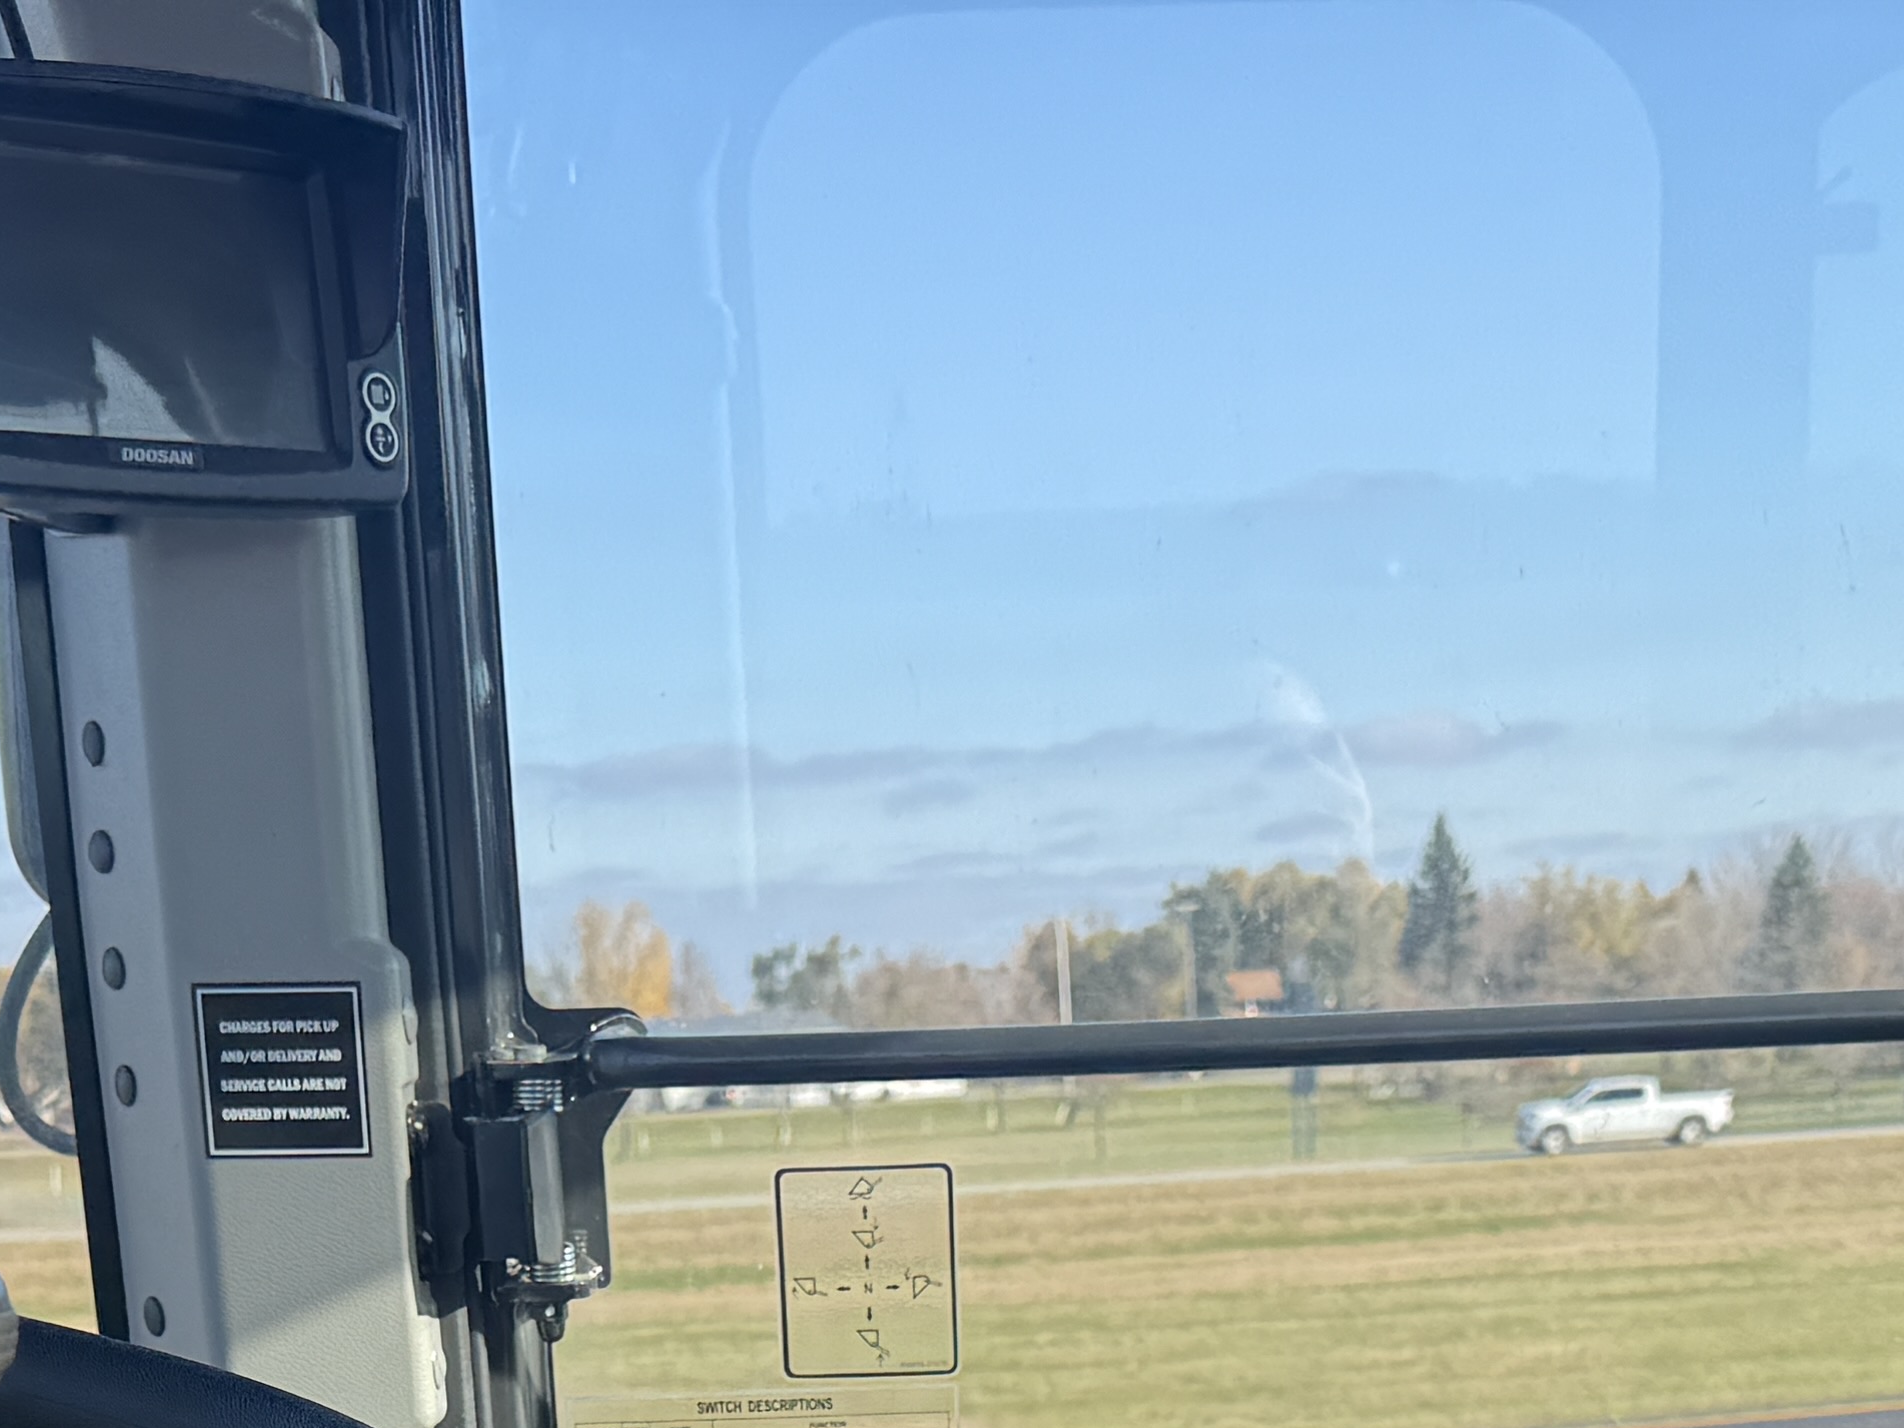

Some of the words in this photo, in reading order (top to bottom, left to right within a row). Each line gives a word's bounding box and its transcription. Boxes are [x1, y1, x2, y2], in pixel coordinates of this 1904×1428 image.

[121, 447, 194, 465] DOOSAN
[219, 1020, 271, 1033] CHARGES
[272, 1020, 294, 1033] FOR
[296, 1020, 322, 1033] PICK
[323, 1020, 339, 1032] UP
[220, 1050, 266, 1065] AND/OR
[268, 1049, 318, 1062] DELIVERY
[318, 1048, 342, 1062] AND
[221, 1079, 266, 1092] SERVICE
[267, 1078, 301, 1091] CALLS
[302, 1078, 324, 1091] ARE
[325, 1077, 347, 1091] NOT
[222, 1108, 272, 1121] COVERED
[273, 1107, 288, 1120] BY
[288, 1107, 350, 1120] WARRANTY.
[864, 1282, 873, 1294] N
[697, 1400, 742, 1415] SWITCH
[748, 1398, 833, 1413] DESCRIPTIONS
